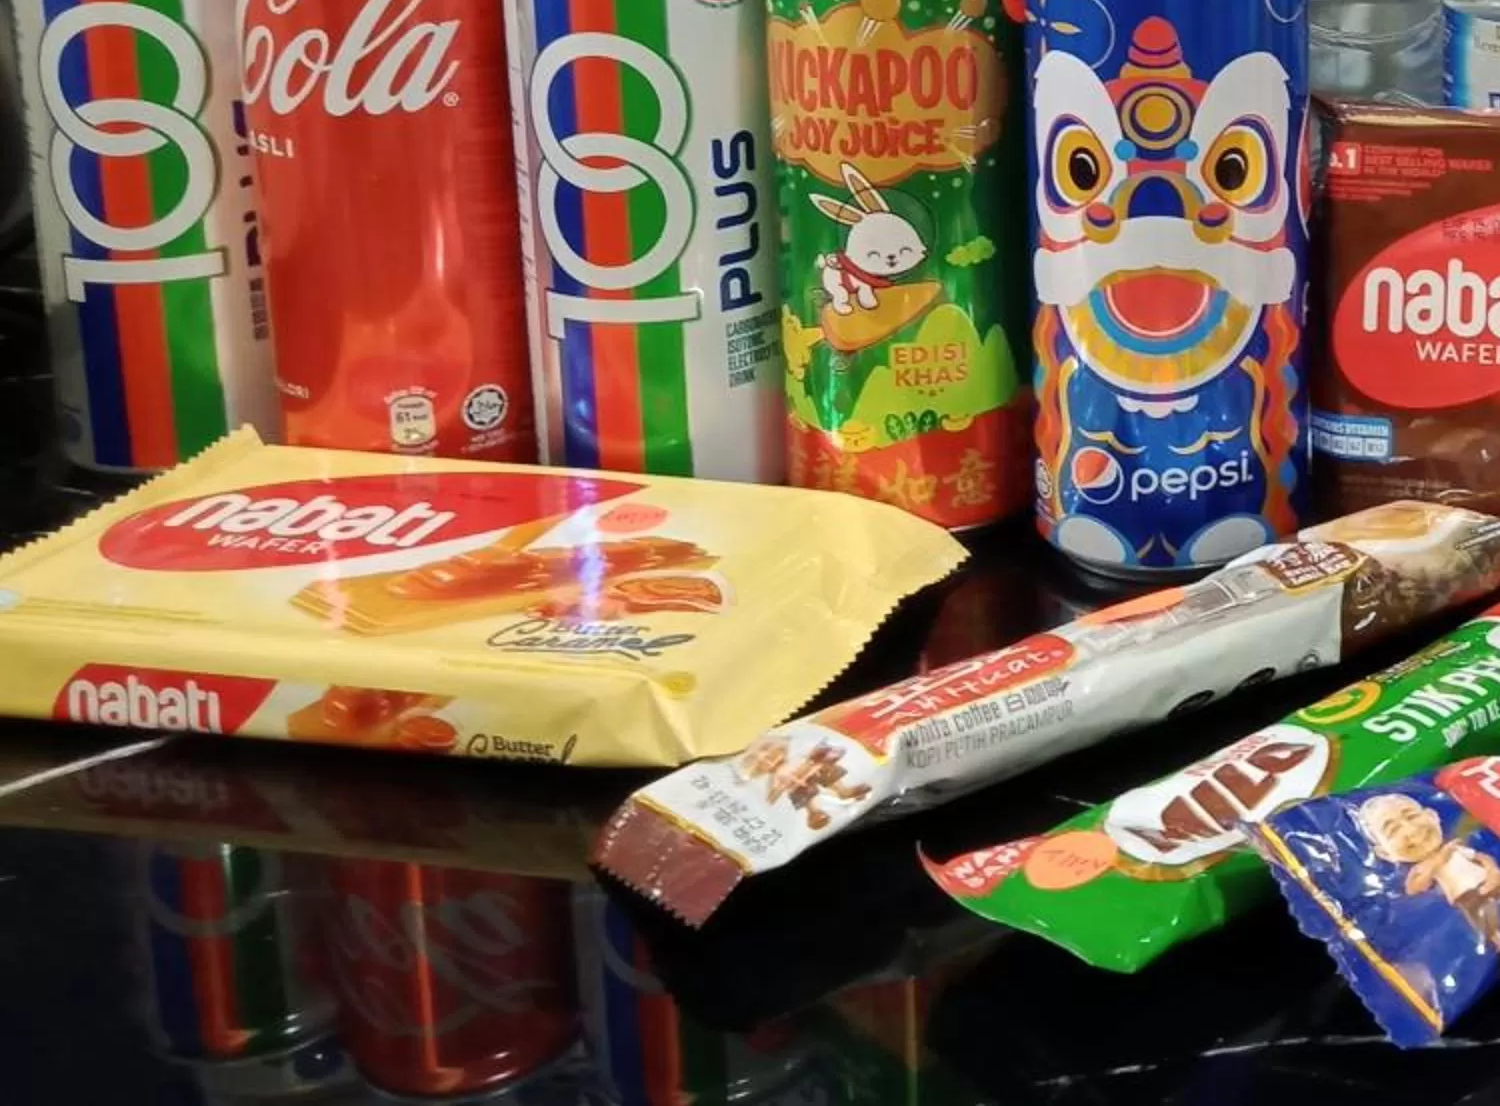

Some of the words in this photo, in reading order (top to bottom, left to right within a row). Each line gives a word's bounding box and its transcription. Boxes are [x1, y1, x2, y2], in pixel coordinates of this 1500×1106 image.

[789, 115, 841, 151] JOY
[840, 116, 946, 159] JUICE
[711, 128, 763, 313] PLUS
[894, 342, 967, 366] EDISI
[895, 365, 969, 387] KHAS
[1131, 450, 1254, 502] pepsi
[164, 493, 457, 548] nabati
[207, 531, 327, 555] WAFER
[67, 672, 224, 735] nabati
[1362, 683, 1475, 743] STIK
[494, 734, 555, 759] Butter
[1123, 741, 1317, 854] MILO
